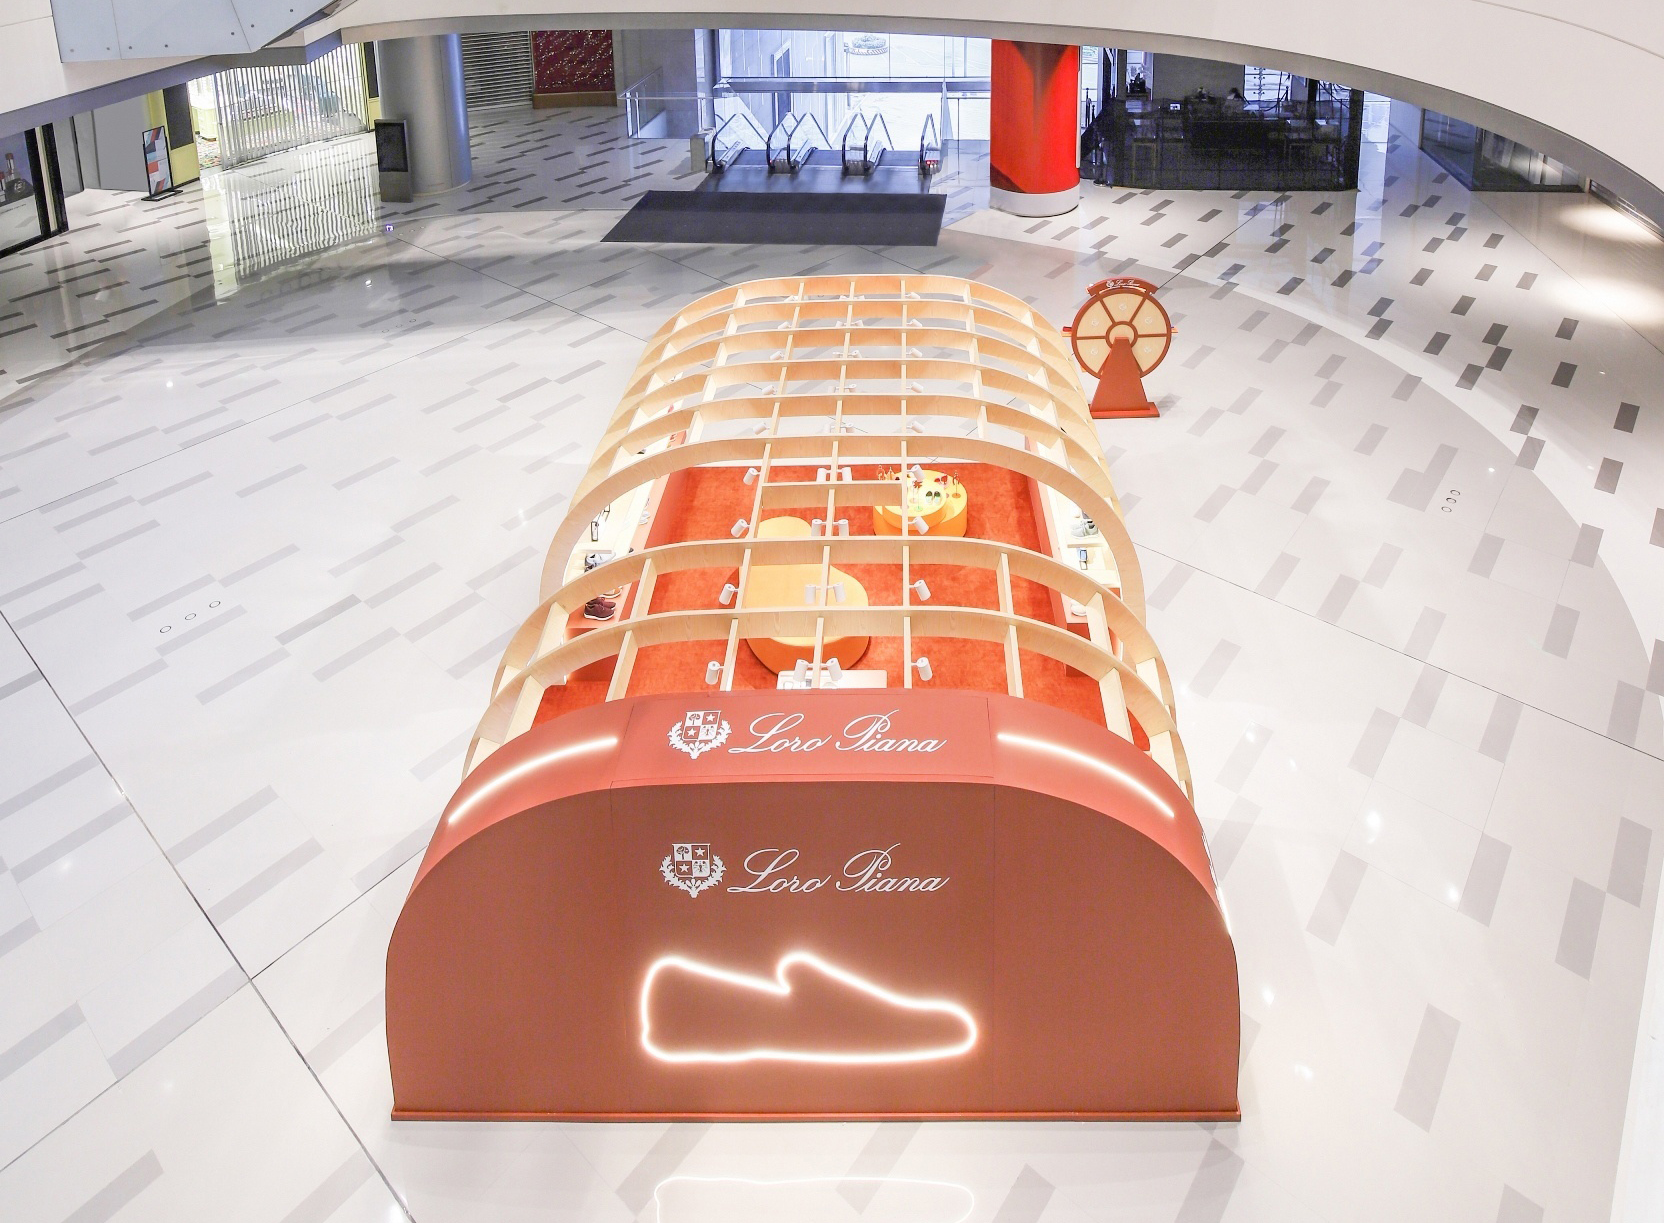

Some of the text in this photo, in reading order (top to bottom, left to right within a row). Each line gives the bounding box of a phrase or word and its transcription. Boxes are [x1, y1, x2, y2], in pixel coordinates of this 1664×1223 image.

[728, 709, 948, 754] Loro Piana
[727, 843, 950, 893] Loro Piana
